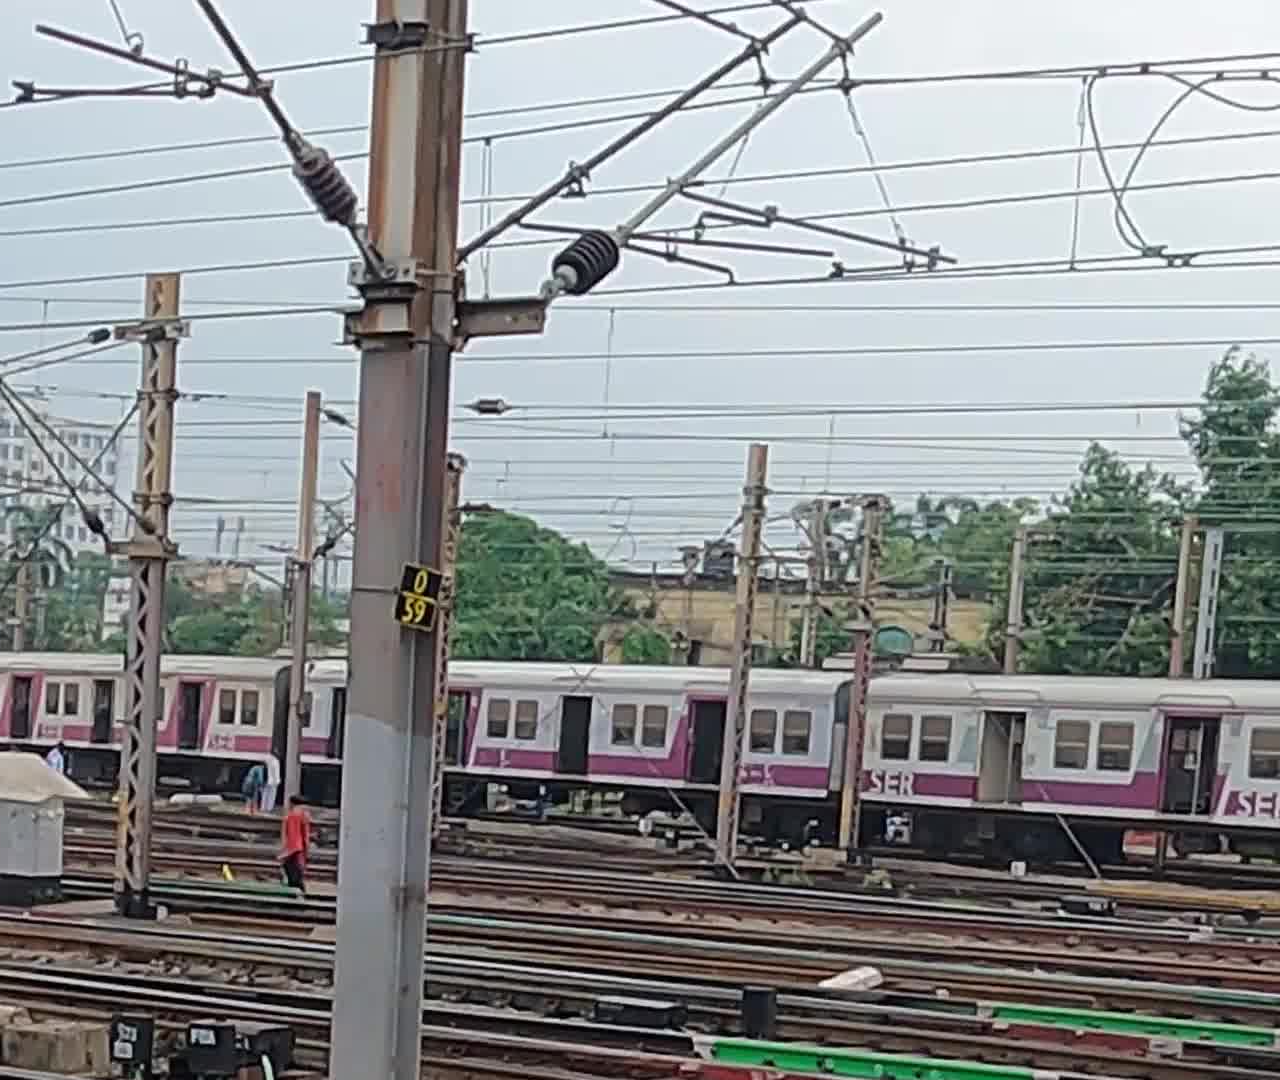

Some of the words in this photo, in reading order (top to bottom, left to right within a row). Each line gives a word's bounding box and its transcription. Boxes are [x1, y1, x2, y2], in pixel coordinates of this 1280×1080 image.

[414, 569, 428, 594] 0
[401, 597, 427, 623] 59
[869, 769, 914, 796] SER
